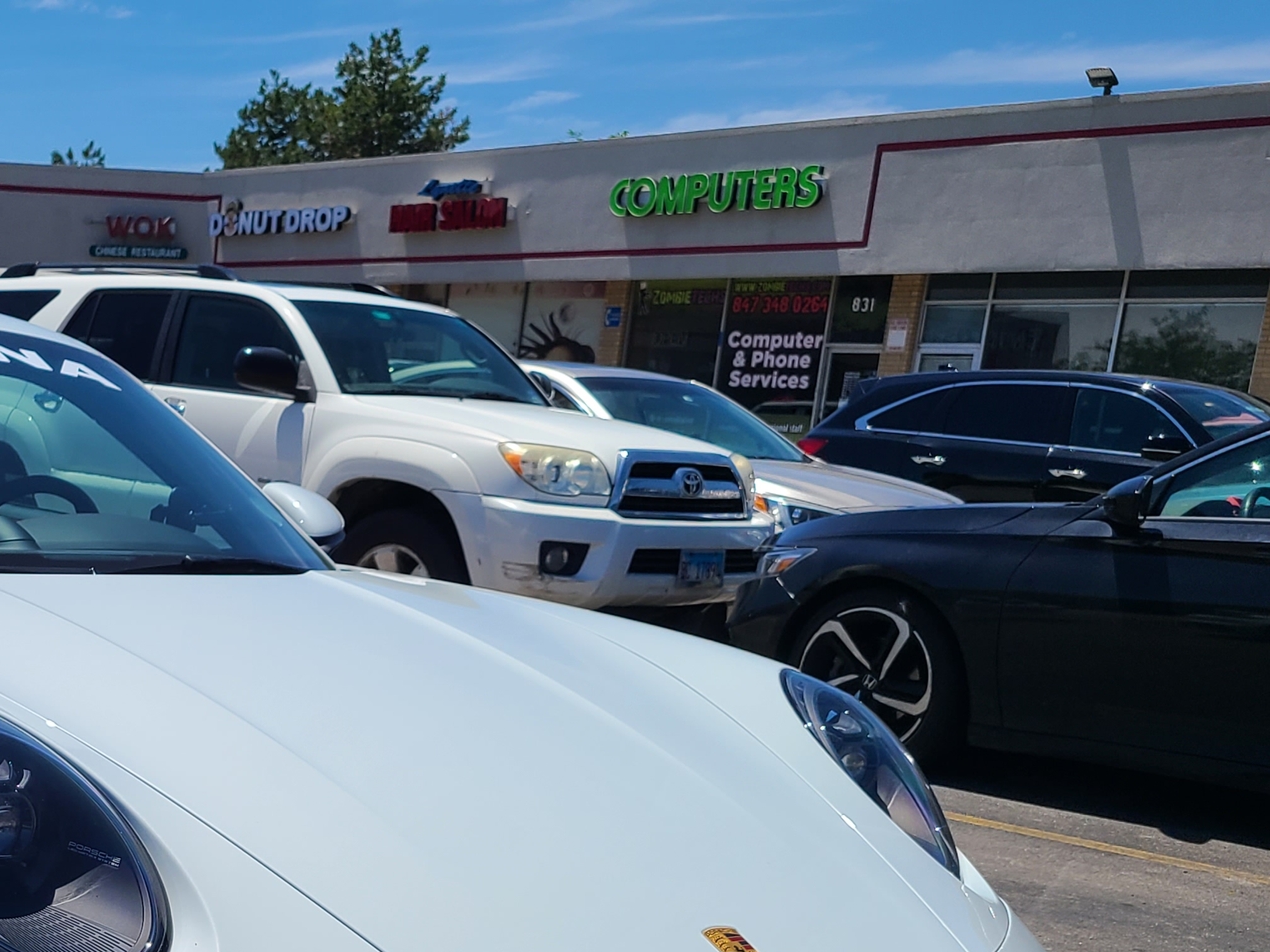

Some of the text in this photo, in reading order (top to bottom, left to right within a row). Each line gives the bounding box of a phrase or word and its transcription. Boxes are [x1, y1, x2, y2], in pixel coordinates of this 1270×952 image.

[608, 164, 825, 218] COMPUTERS
[105, 215, 176, 239] WOK
[209, 205, 349, 237] DONUT DROP
[732, 295, 829, 313] 847 348 0264
[852, 297, 875, 313] 831
[727, 331, 824, 351] Computer
[732, 350, 811, 369] & Phone
[728, 370, 809, 389] Services
[68, 841, 121, 864] PORSCHE
